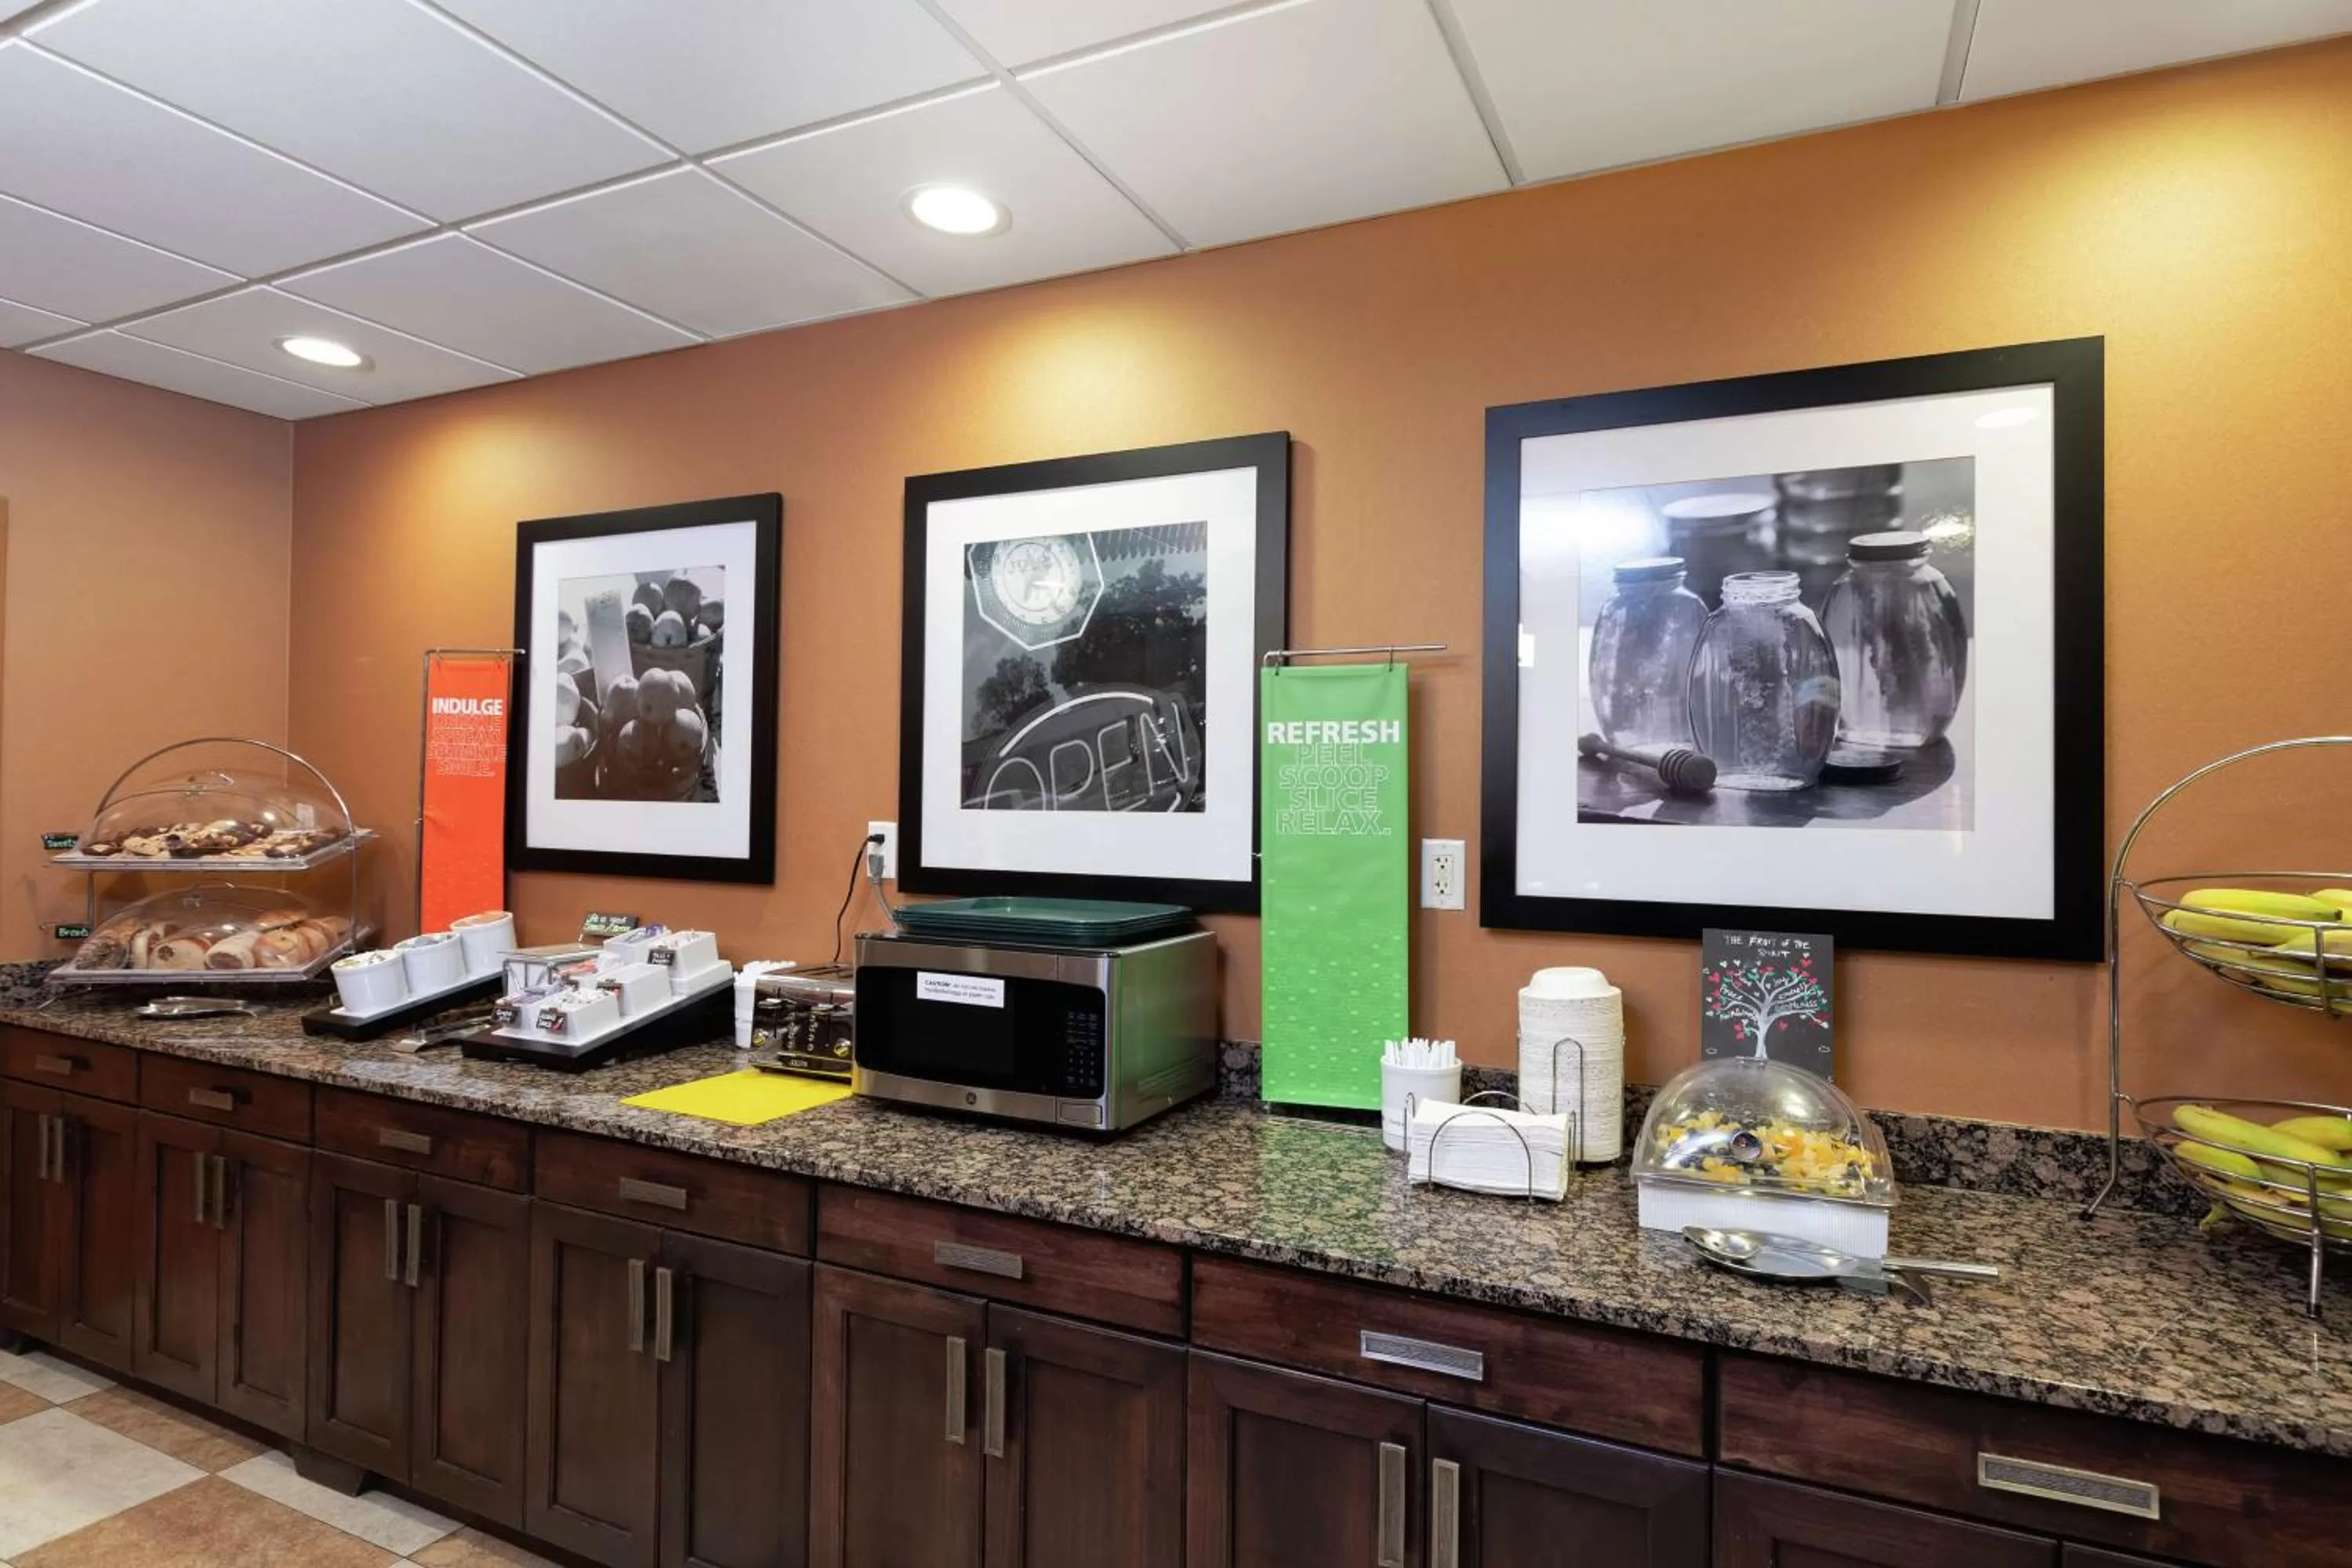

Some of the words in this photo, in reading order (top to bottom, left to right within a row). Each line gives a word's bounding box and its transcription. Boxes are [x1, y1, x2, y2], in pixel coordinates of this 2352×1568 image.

[433, 698, 503, 715] INDULGE
[1267, 720, 1399, 744] REFRESH
[985, 702, 1188, 812] OPEN
[1297, 742, 1367, 766] PEEL
[1279, 764, 1391, 789] SCOOP
[1290, 787, 1377, 811] SLICE
[1276, 809, 1392, 834] RELAX.
